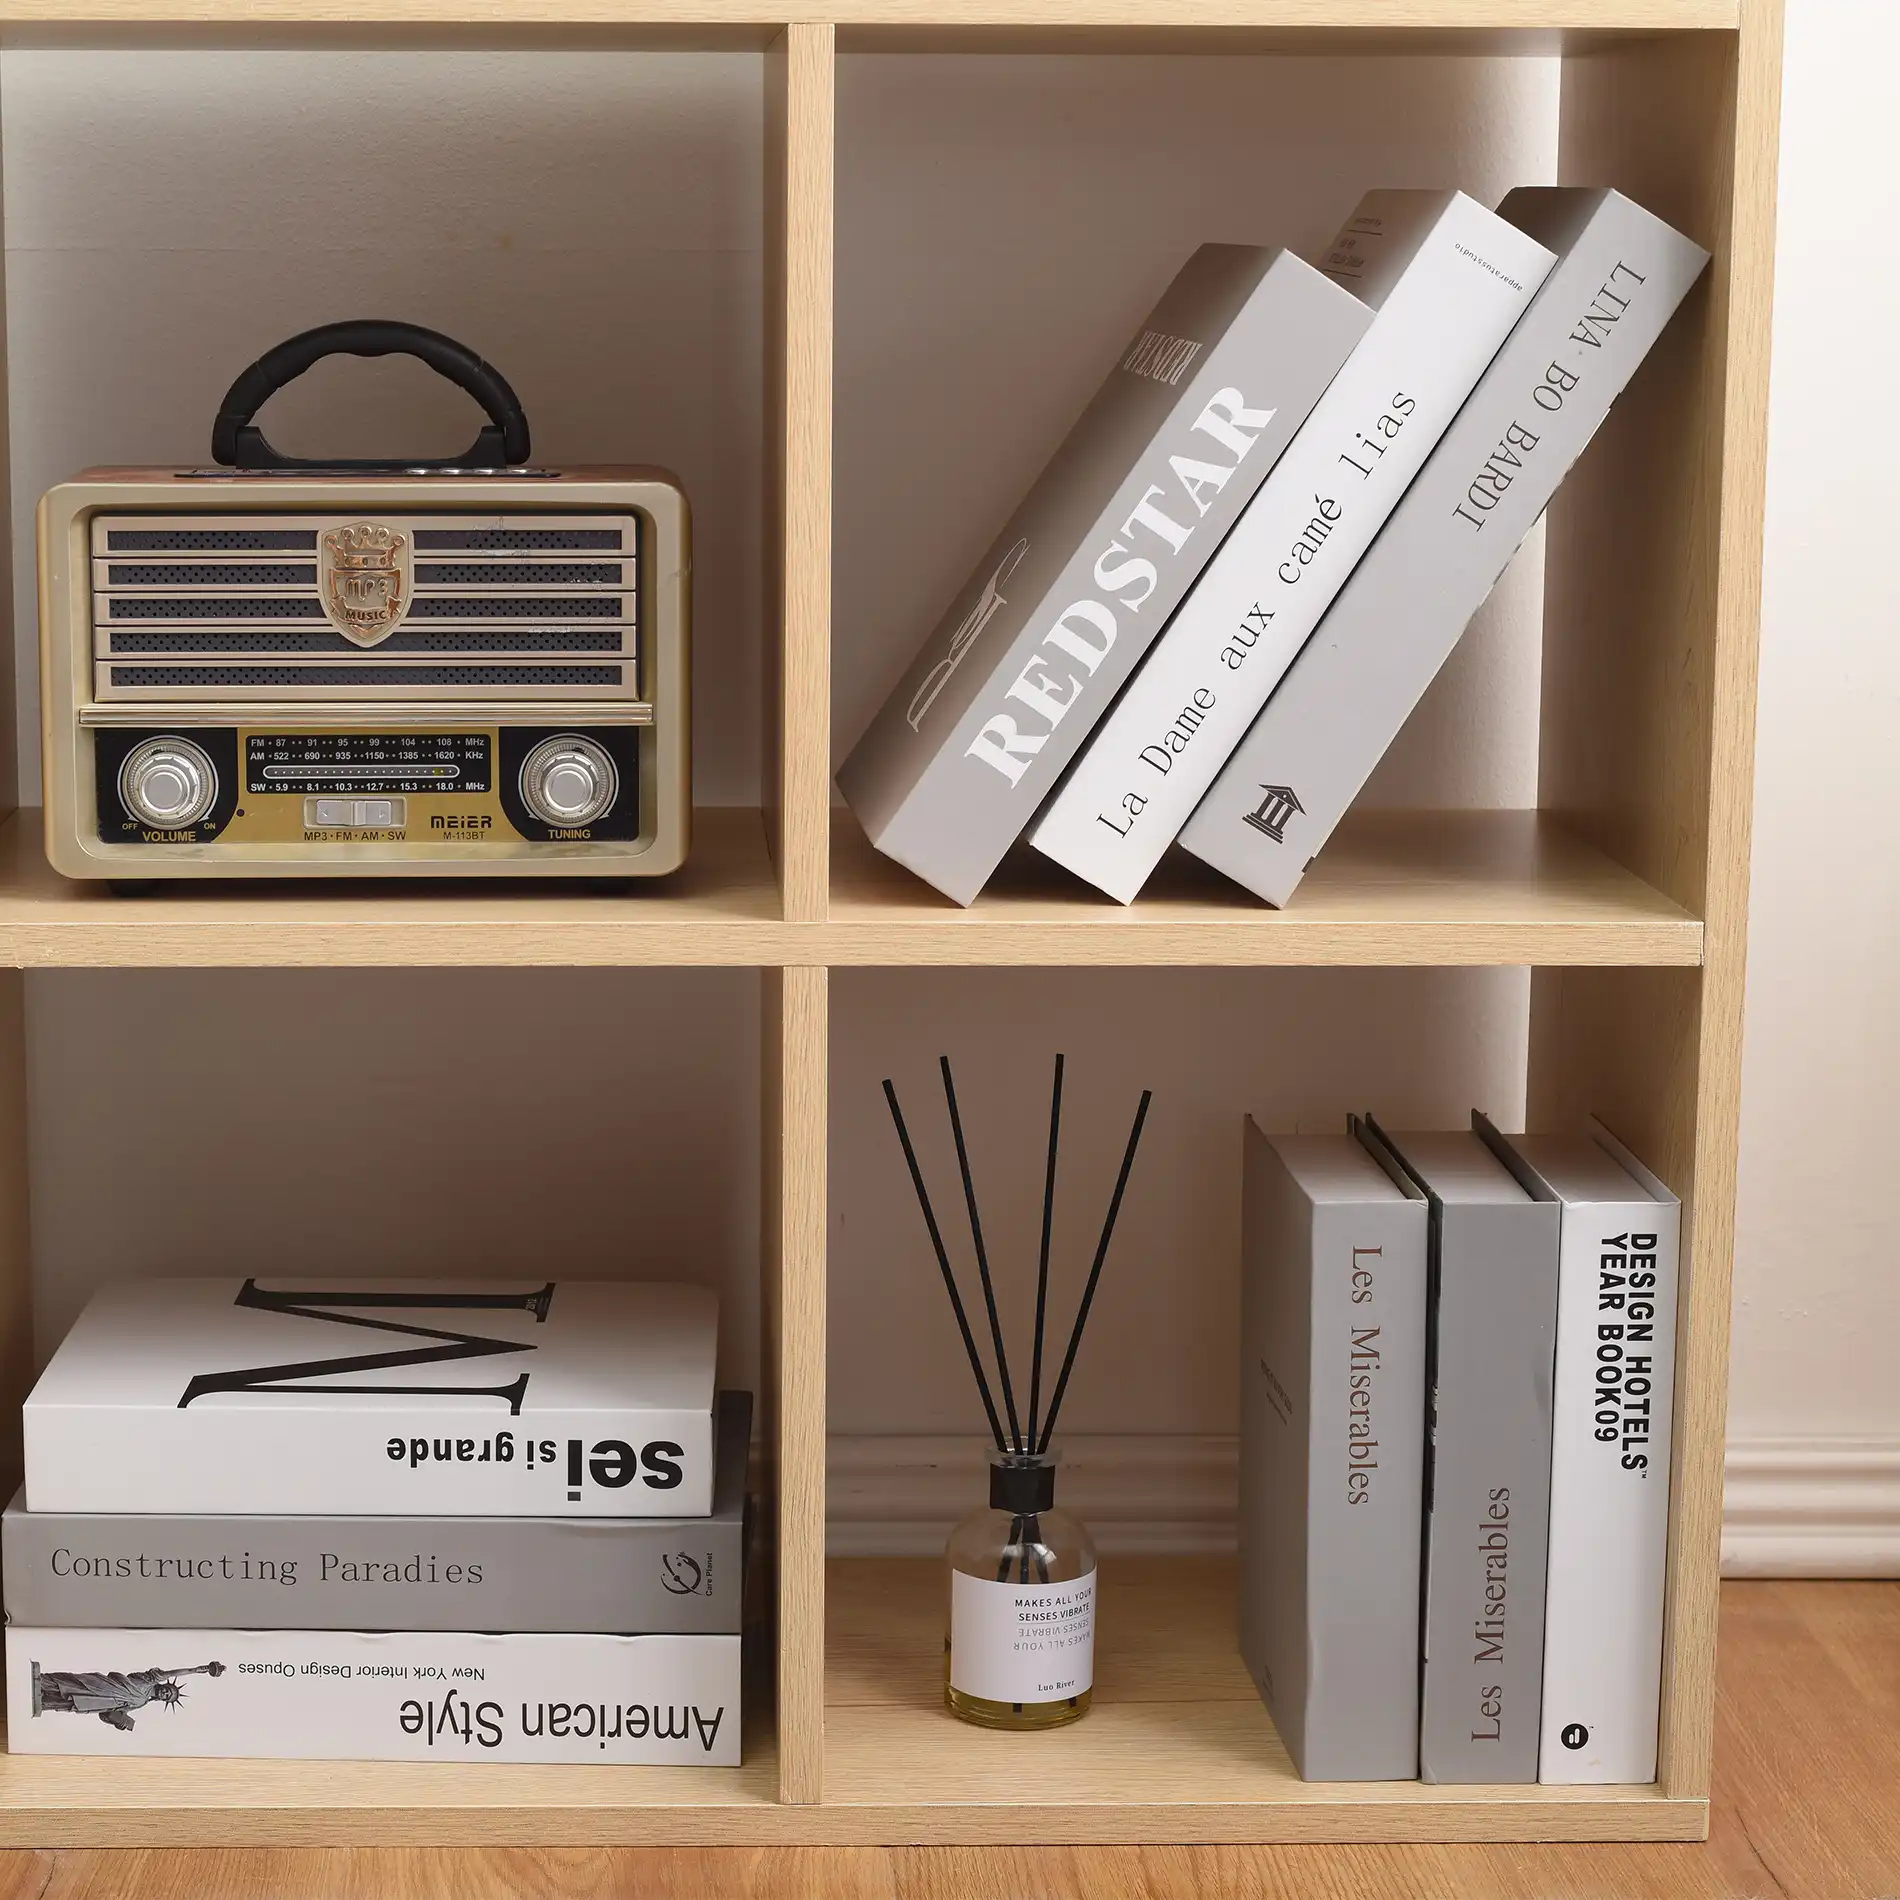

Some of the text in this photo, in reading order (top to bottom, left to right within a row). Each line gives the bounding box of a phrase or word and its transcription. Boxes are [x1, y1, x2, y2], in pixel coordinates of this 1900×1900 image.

[1124, 329, 1204, 388] REDSTAR
[1451, 261, 1646, 532] LINA BO BARDI
[346, 579, 388, 601] MP3
[964, 385, 1277, 789] REDSTAR
[345, 610, 386, 620] MUSIC
[1096, 391, 1417, 840] La Dame aux camé lias
[251, 738, 485, 747] FM 87 91 95 99 104 108 MHz
[250, 752, 483, 760] AM 522 690 935 1150 1385 1620 KHz
[251, 783, 485, 791] SW 5.9 8.1 10.3 12.7 15.3 18.0 MHz
[122, 822, 138, 830] OFF
[204, 822, 216, 830] ON
[443, 831, 486, 840] M-113BT
[547, 829, 592, 840] TUNING
[143, 831, 196, 842] VOLUME
[304, 831, 406, 841] MP3 FM AM SW
[1599, 1232, 1628, 1311] YEAR
[1625, 1231, 1657, 1344] DESIGN
[176, 1278, 556, 1416] M
[1347, 1243, 1384, 1506] Les Miserables
[386, 1432, 685, 1501] sei si grande
[50, 1546, 485, 1586] Constructing Paradies
[1015, 1588, 1092, 1607] MAKES ALL YOUR
[1018, 1603, 1090, 1621] SENSES VIBRATE
[1470, 1486, 1512, 1744] Les Miserables
[1018, 1618, 1089, 1637] SENSES VIBRATE
[1013, 1642, 1044, 1650] YOUR
[1049, 1640, 1065, 1649] ALL
[238, 1660, 486, 1681] New York Interior Design Opuses
[1057, 1680, 1075, 1689] River
[399, 1688, 725, 1752] American Style
